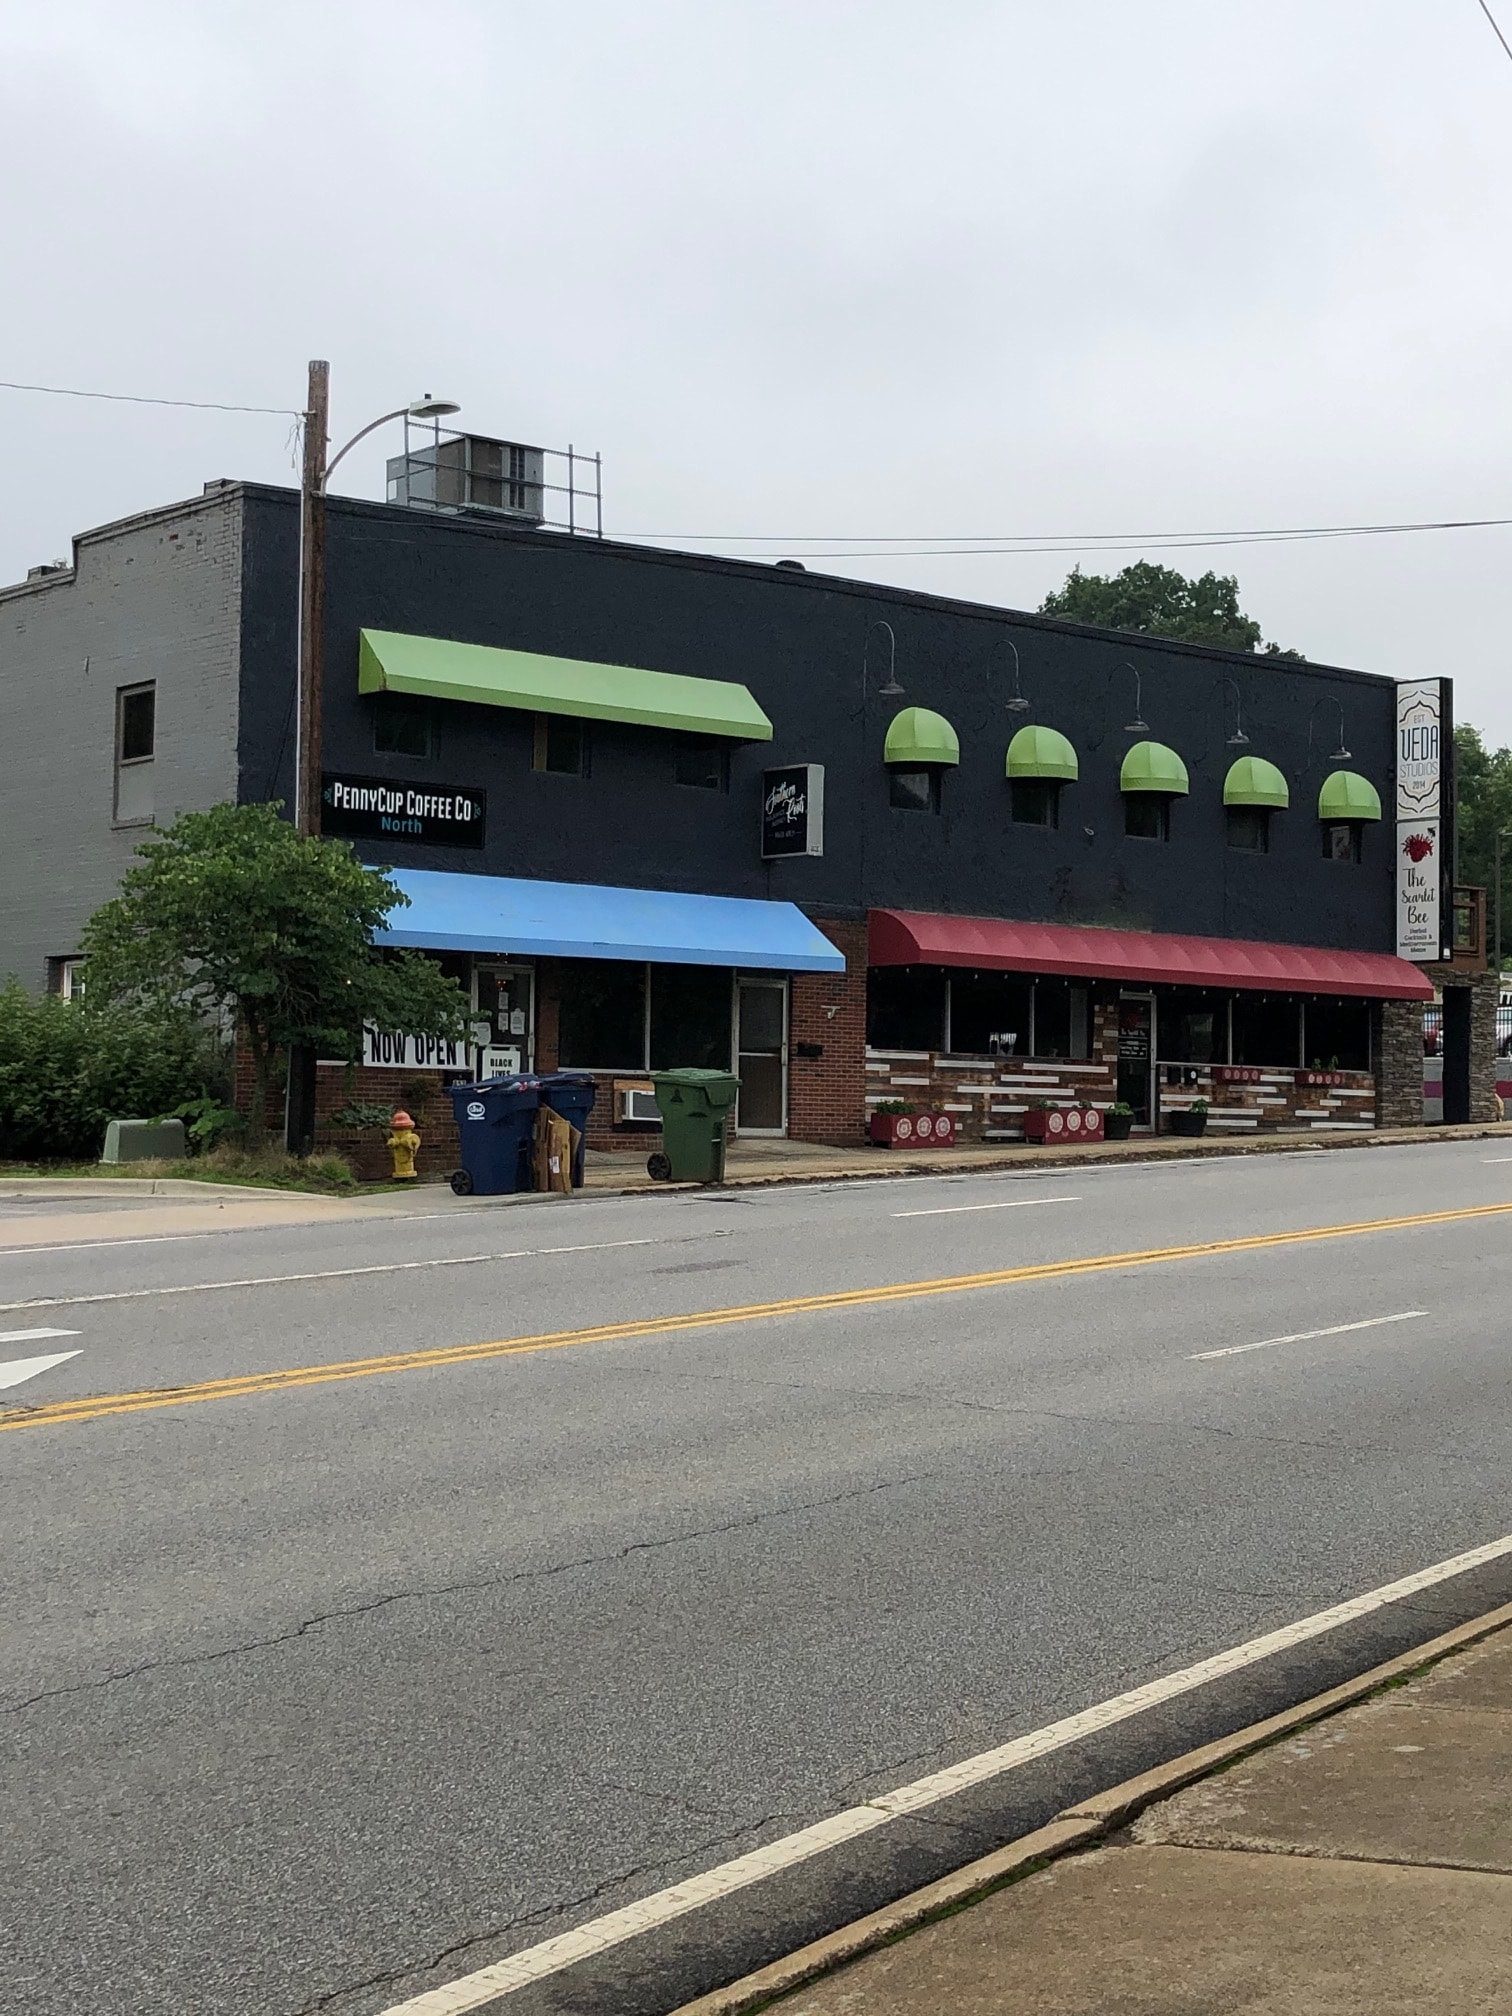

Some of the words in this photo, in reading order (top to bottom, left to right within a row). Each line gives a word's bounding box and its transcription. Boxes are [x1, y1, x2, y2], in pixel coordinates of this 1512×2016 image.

[1400, 725, 1438, 761] VEDA
[1400, 761, 1438, 778] STUDIOS
[406, 790, 452, 819] COFFEE
[455, 796, 471, 821] CO
[381, 816, 422, 834] North
[1402, 867, 1426, 887] The
[1401, 887, 1436, 904] Scarlet
[1407, 905, 1429, 924] Bee
[371, 1031, 406, 1064] NOW
[415, 1034, 457, 1065] OPEN
[490, 1058, 513, 1067] BLACK
